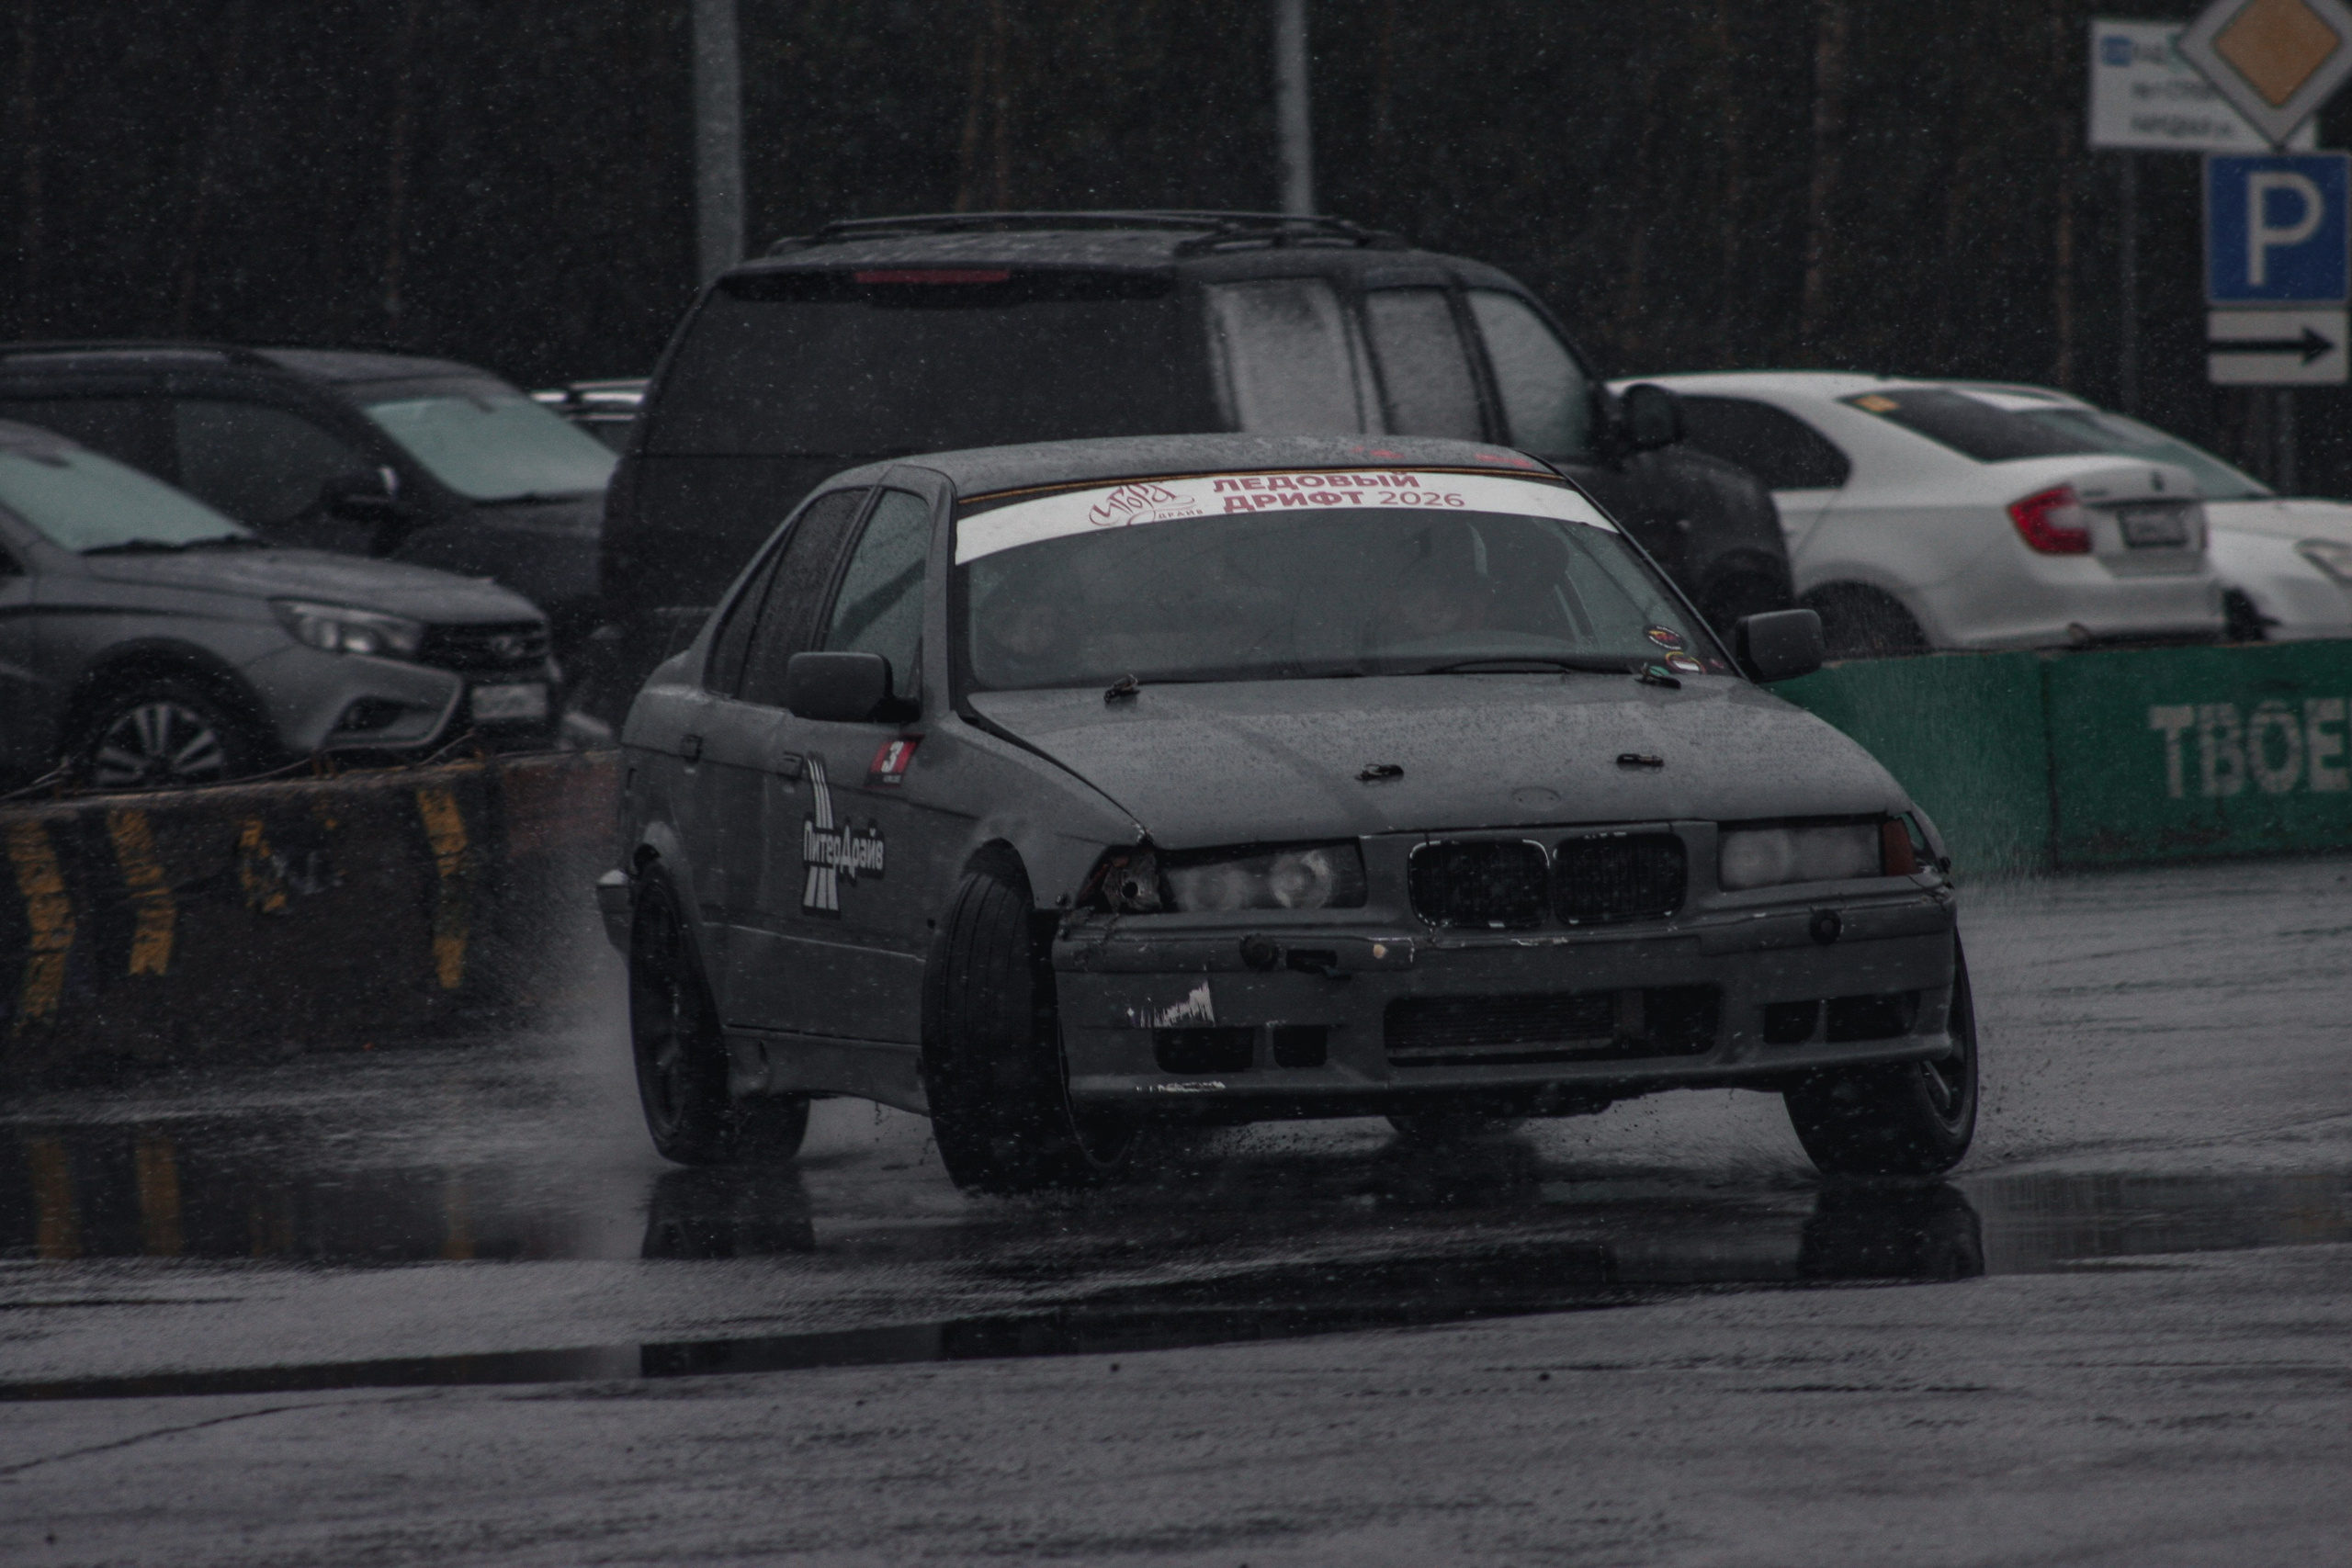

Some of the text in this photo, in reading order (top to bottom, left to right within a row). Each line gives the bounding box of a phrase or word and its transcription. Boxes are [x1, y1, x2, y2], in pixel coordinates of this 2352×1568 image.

[2246, 171, 2325, 286] P
[1213, 472, 1420, 492] ЛЕДОВЫЙ
[1223, 491, 1465, 513] ДРИФТ 2026
[881, 740, 904, 773] 3
[2147, 696, 2352, 799] ТВОЕ
